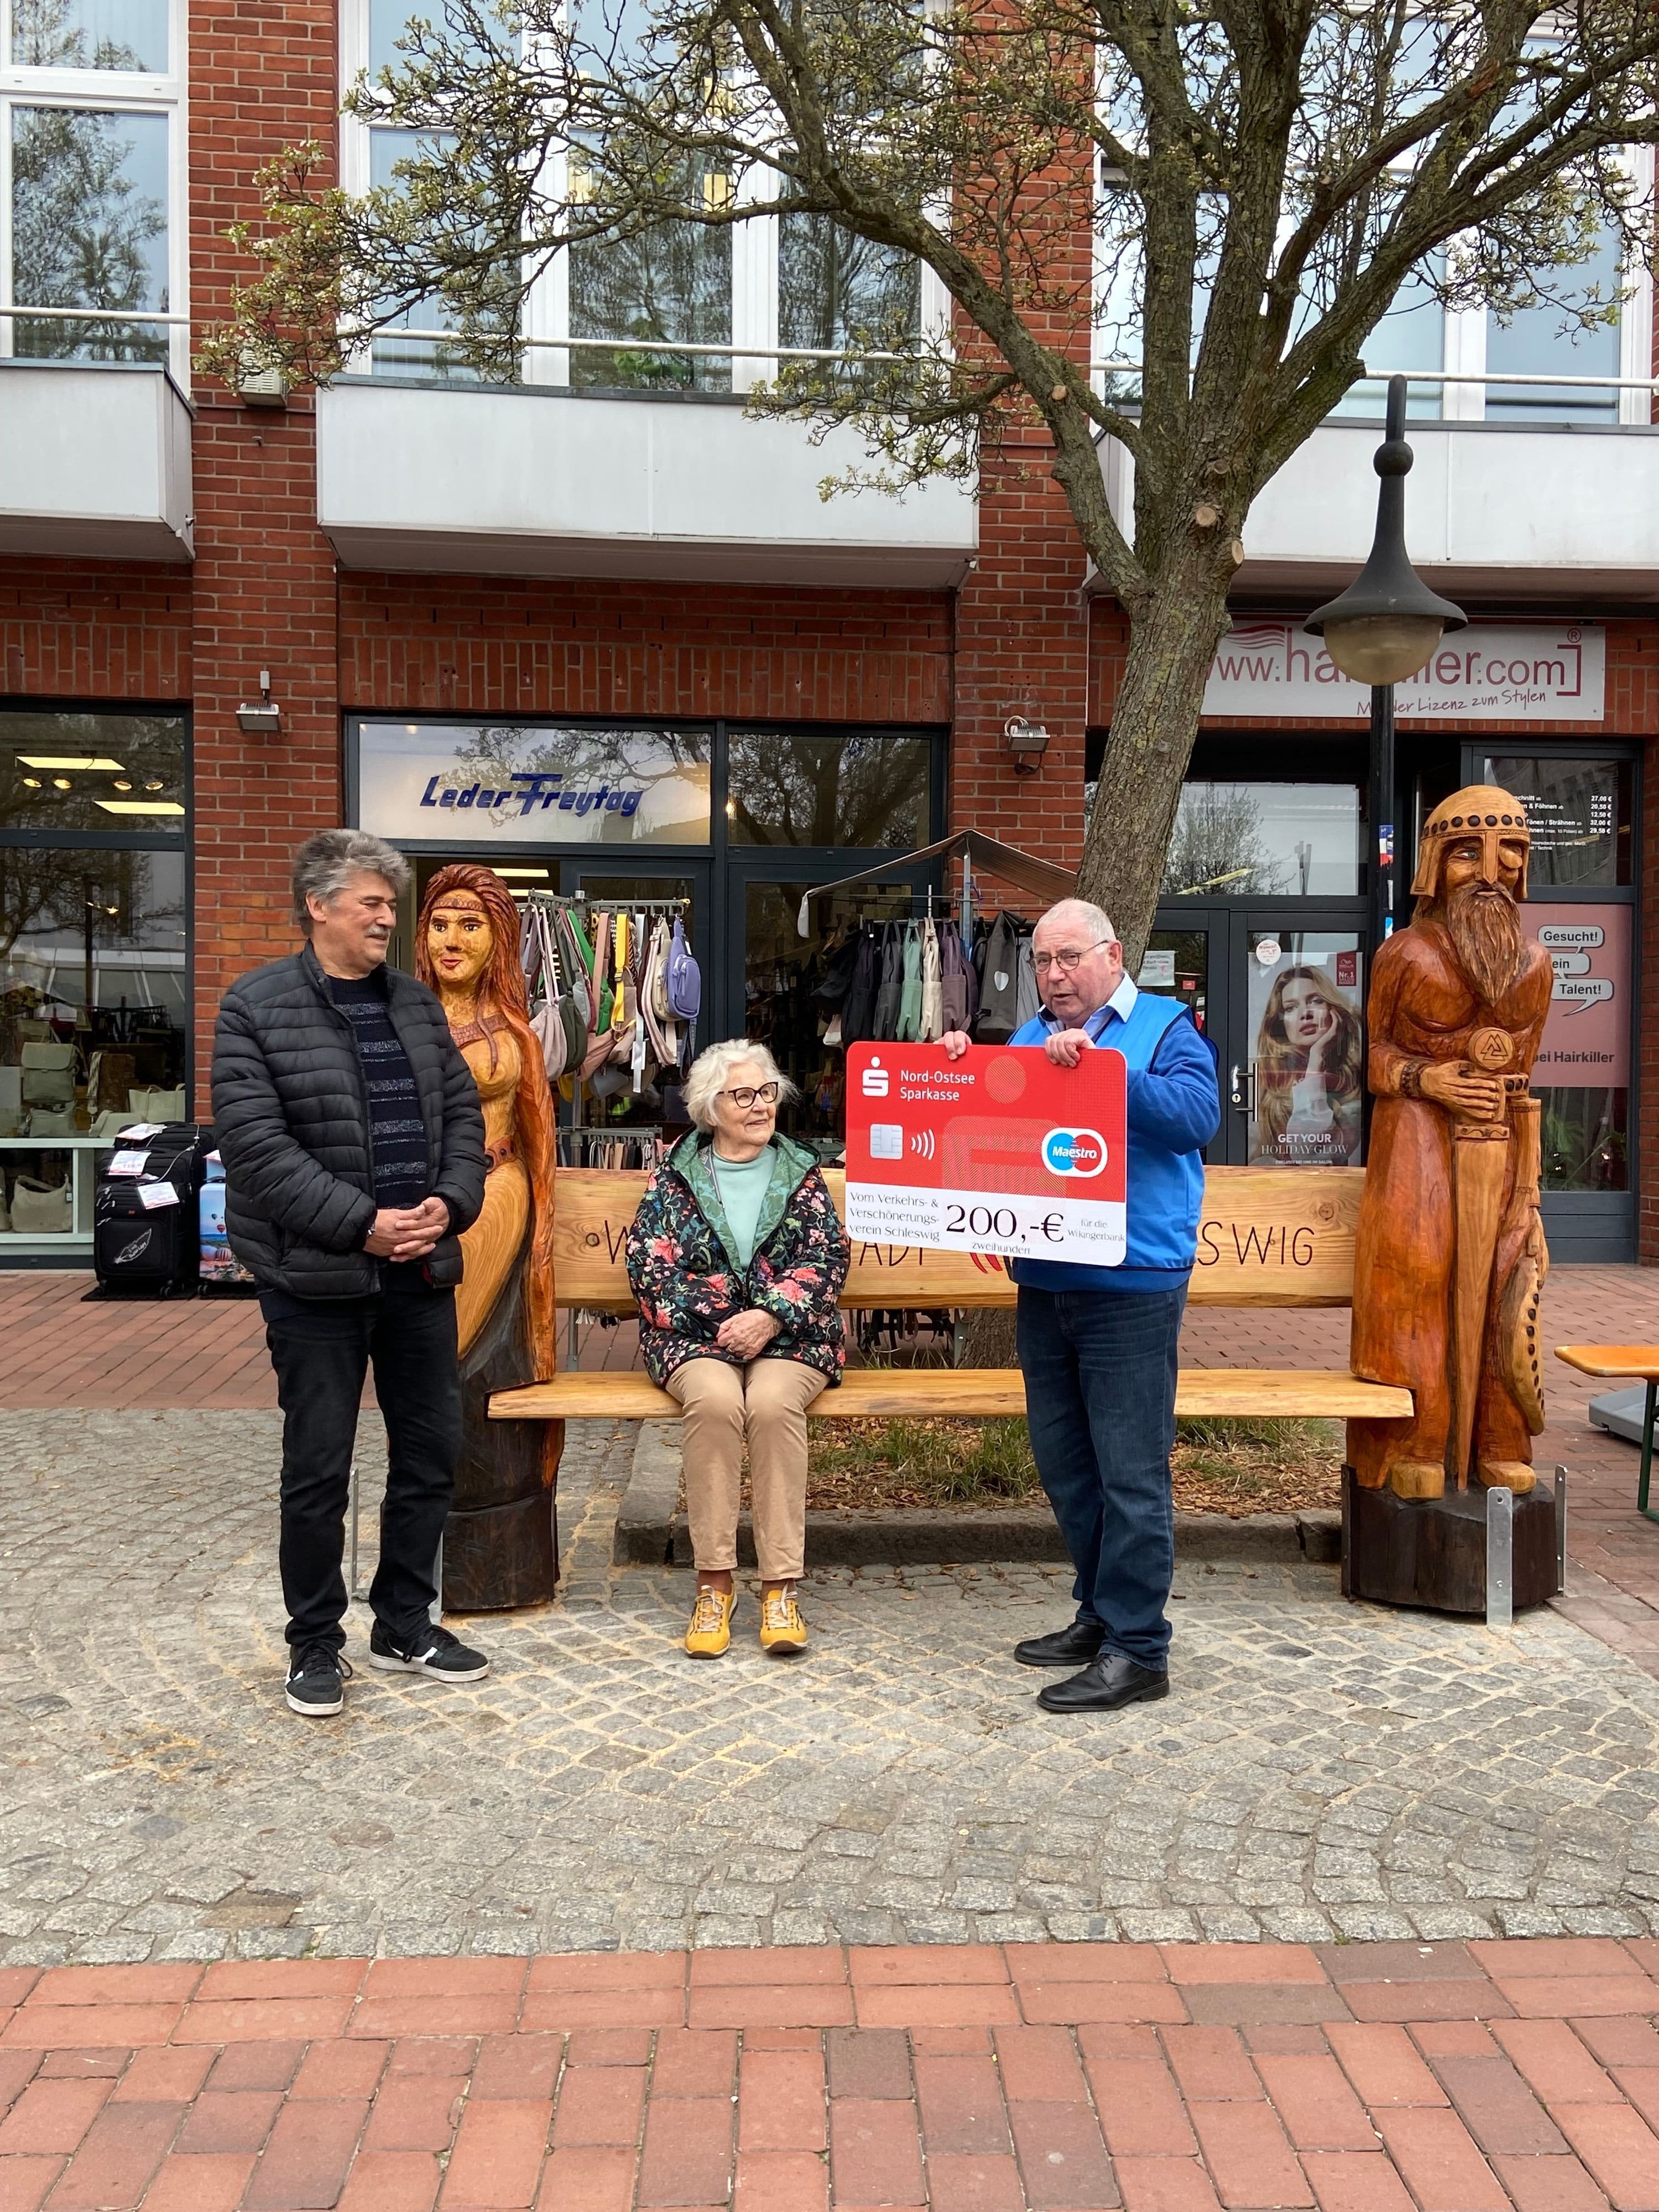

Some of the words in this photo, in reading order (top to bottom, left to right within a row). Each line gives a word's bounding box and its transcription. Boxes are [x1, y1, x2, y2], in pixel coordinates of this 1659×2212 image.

[1418, 697, 1467, 712] Lizenz
[1472, 696, 1498, 707] zum
[1501, 687, 1546, 710] Stylen
[420, 775, 513, 808] Leder
[510, 773, 644, 817] Freytag
[1543, 931, 1598, 942] Gesucht!
[1559, 984, 1601, 995] Talent!
[1554, 1051, 1615, 1063] Hairkiller
[900, 1070, 975, 1084] Nord-Ostsee
[900, 1087, 960, 1102] Sparkasse
[1277, 1134, 1298, 1143] GET
[1300, 1134, 1332, 1143] YOUR
[1052, 1146, 1097, 1159] Maestro
[1261, 1145, 1312, 1155] HOLIDAY
[1313, 1144, 1349, 1155] GLOW
[850, 1192, 874, 1203] Vom
[878, 1194, 928, 1207] Verkehrs-
[931, 1199, 939, 1208] &
[849, 1208, 939, 1225] Verschönerungs-
[1081, 1218, 1092, 1228] für
[849, 1224, 881, 1235] verein
[885, 1226, 940, 1243] Schleswig
[1067, 1229, 1125, 1242] Wikingerbank
[972, 1242, 1031, 1255] zweihundert
[1197, 1221, 1315, 1266] SWIG
